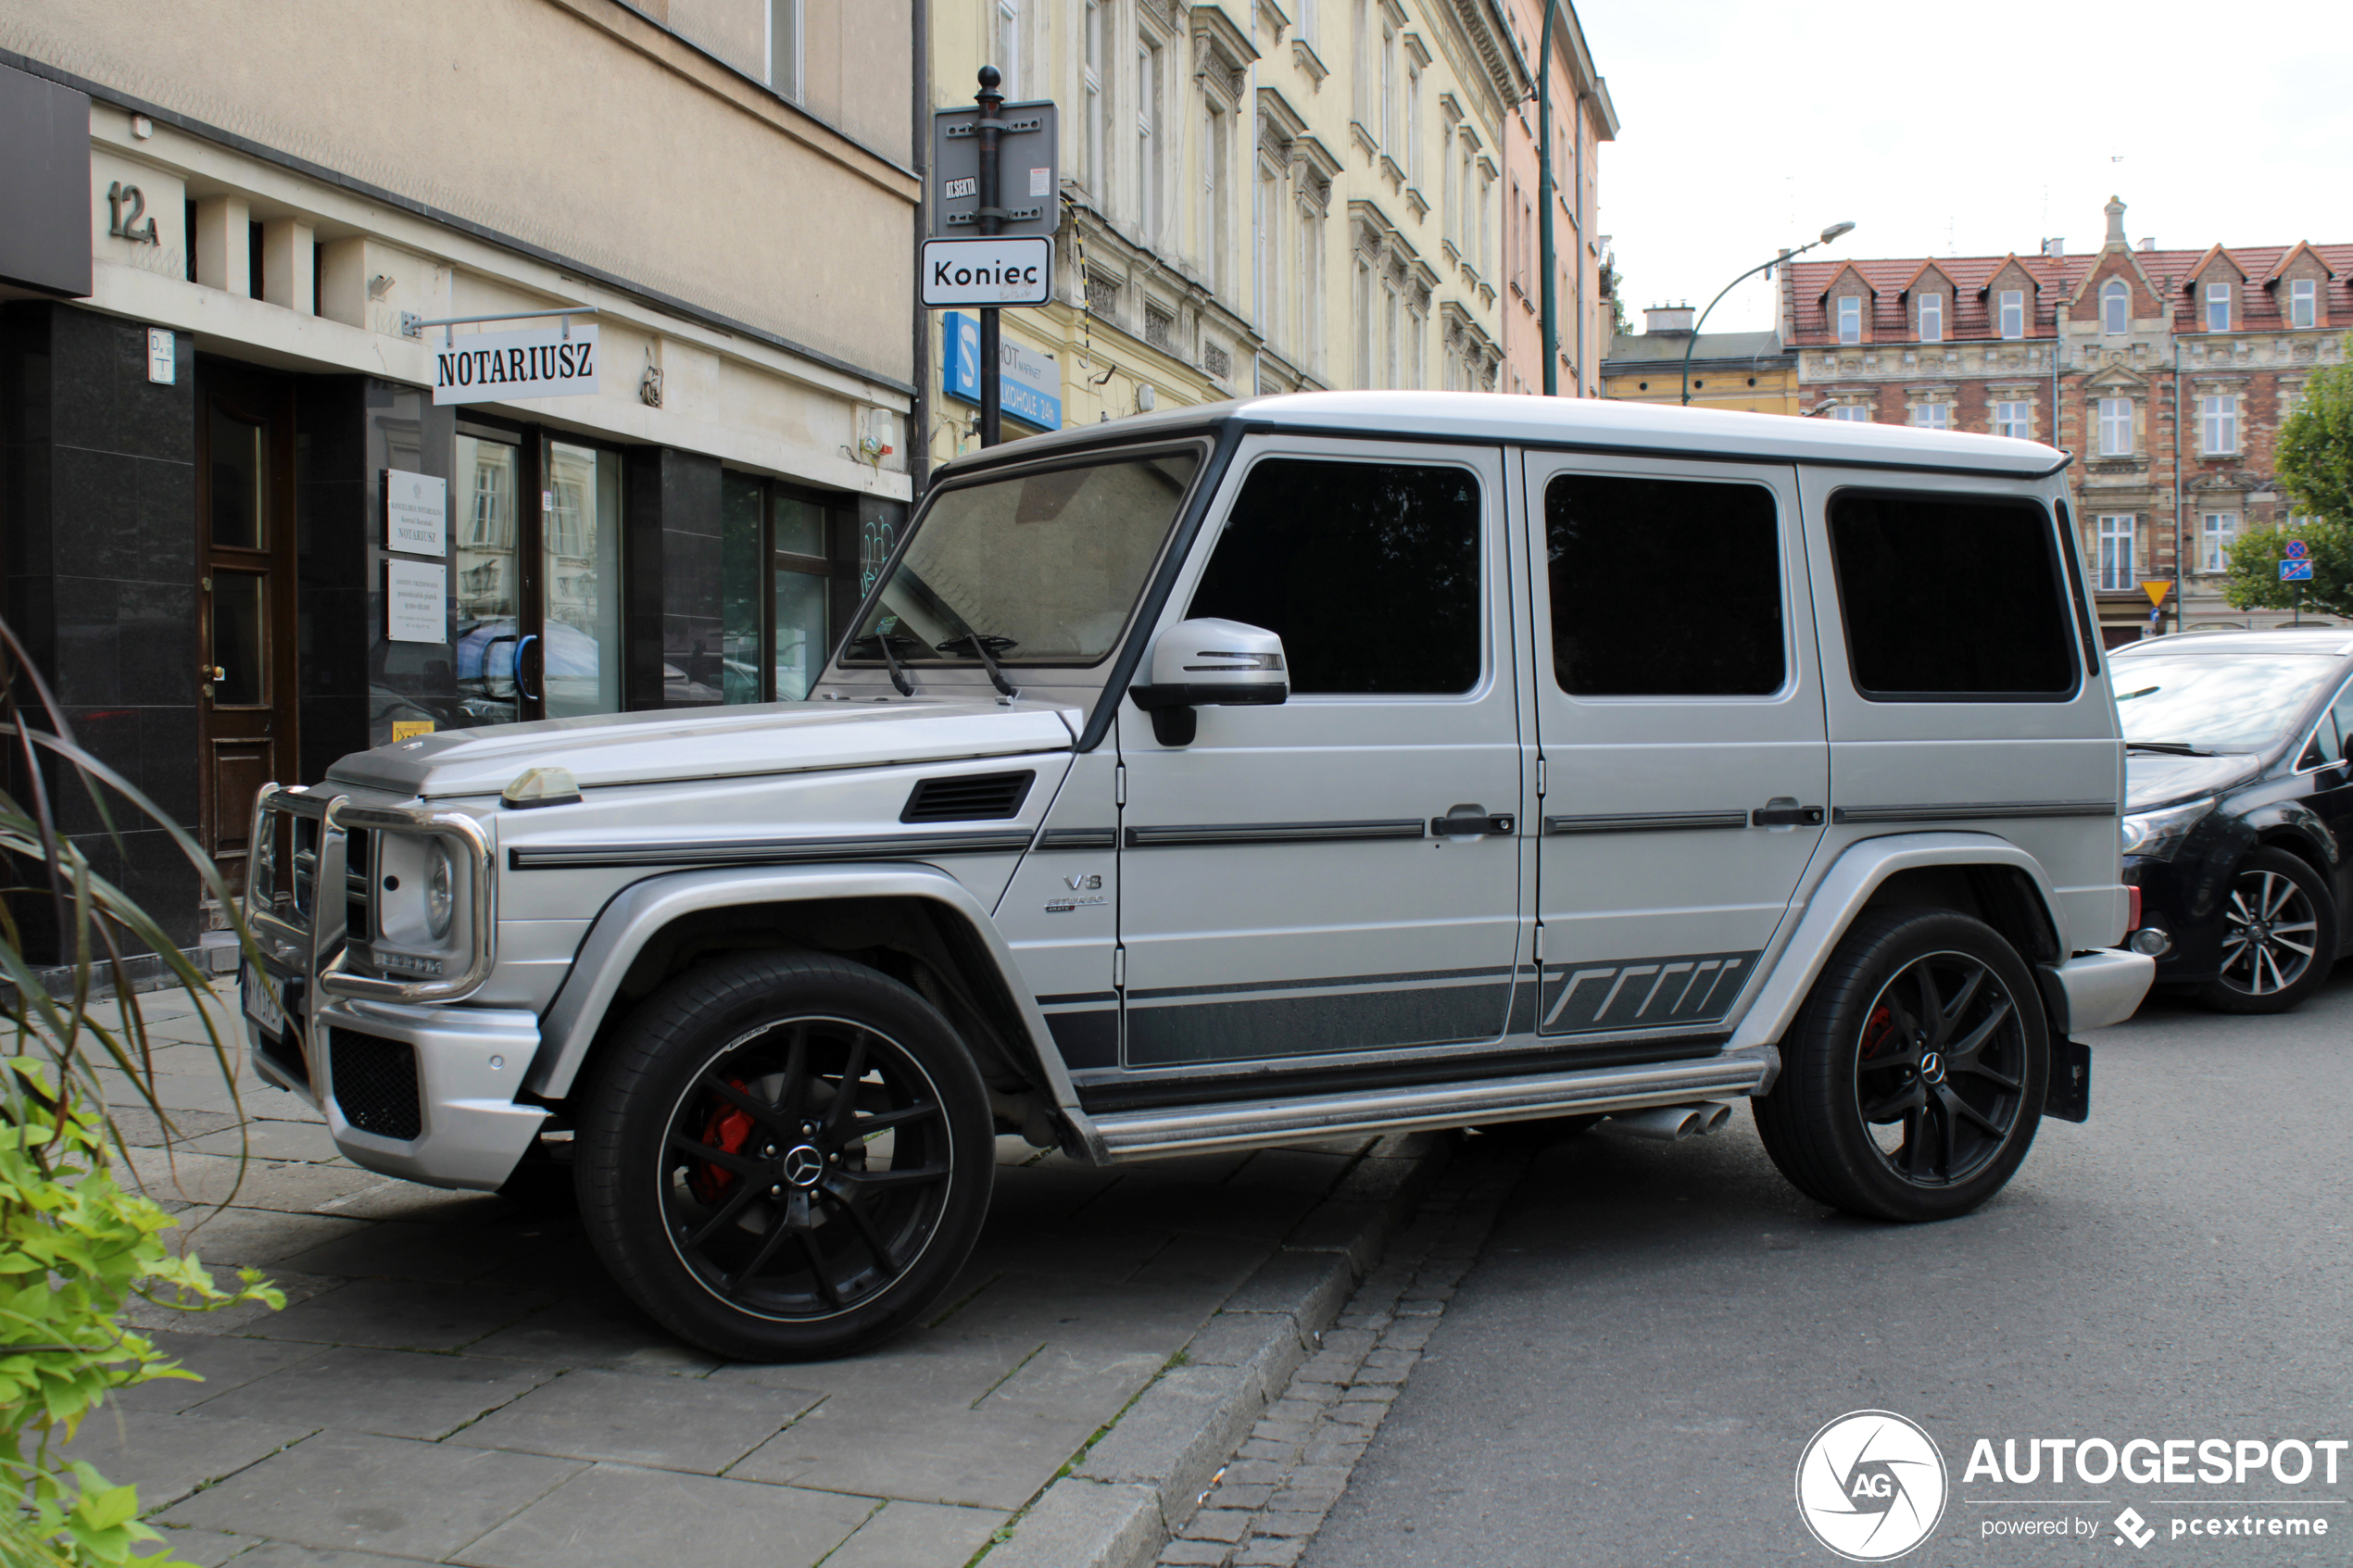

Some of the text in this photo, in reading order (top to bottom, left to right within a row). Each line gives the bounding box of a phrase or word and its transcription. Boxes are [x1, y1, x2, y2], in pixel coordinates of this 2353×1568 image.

[946, 177, 976, 199] AT.SEKTA
[935, 260, 1038, 286] Koniec
[438, 343, 593, 387] NOTARIUSZ
[1018, 360, 1042, 381] MARKET
[1000, 382, 1054, 423] LKOHOLE 24h
[398, 527, 437, 544] NOTARIUSZ
[1063, 875, 1102, 890] V8
